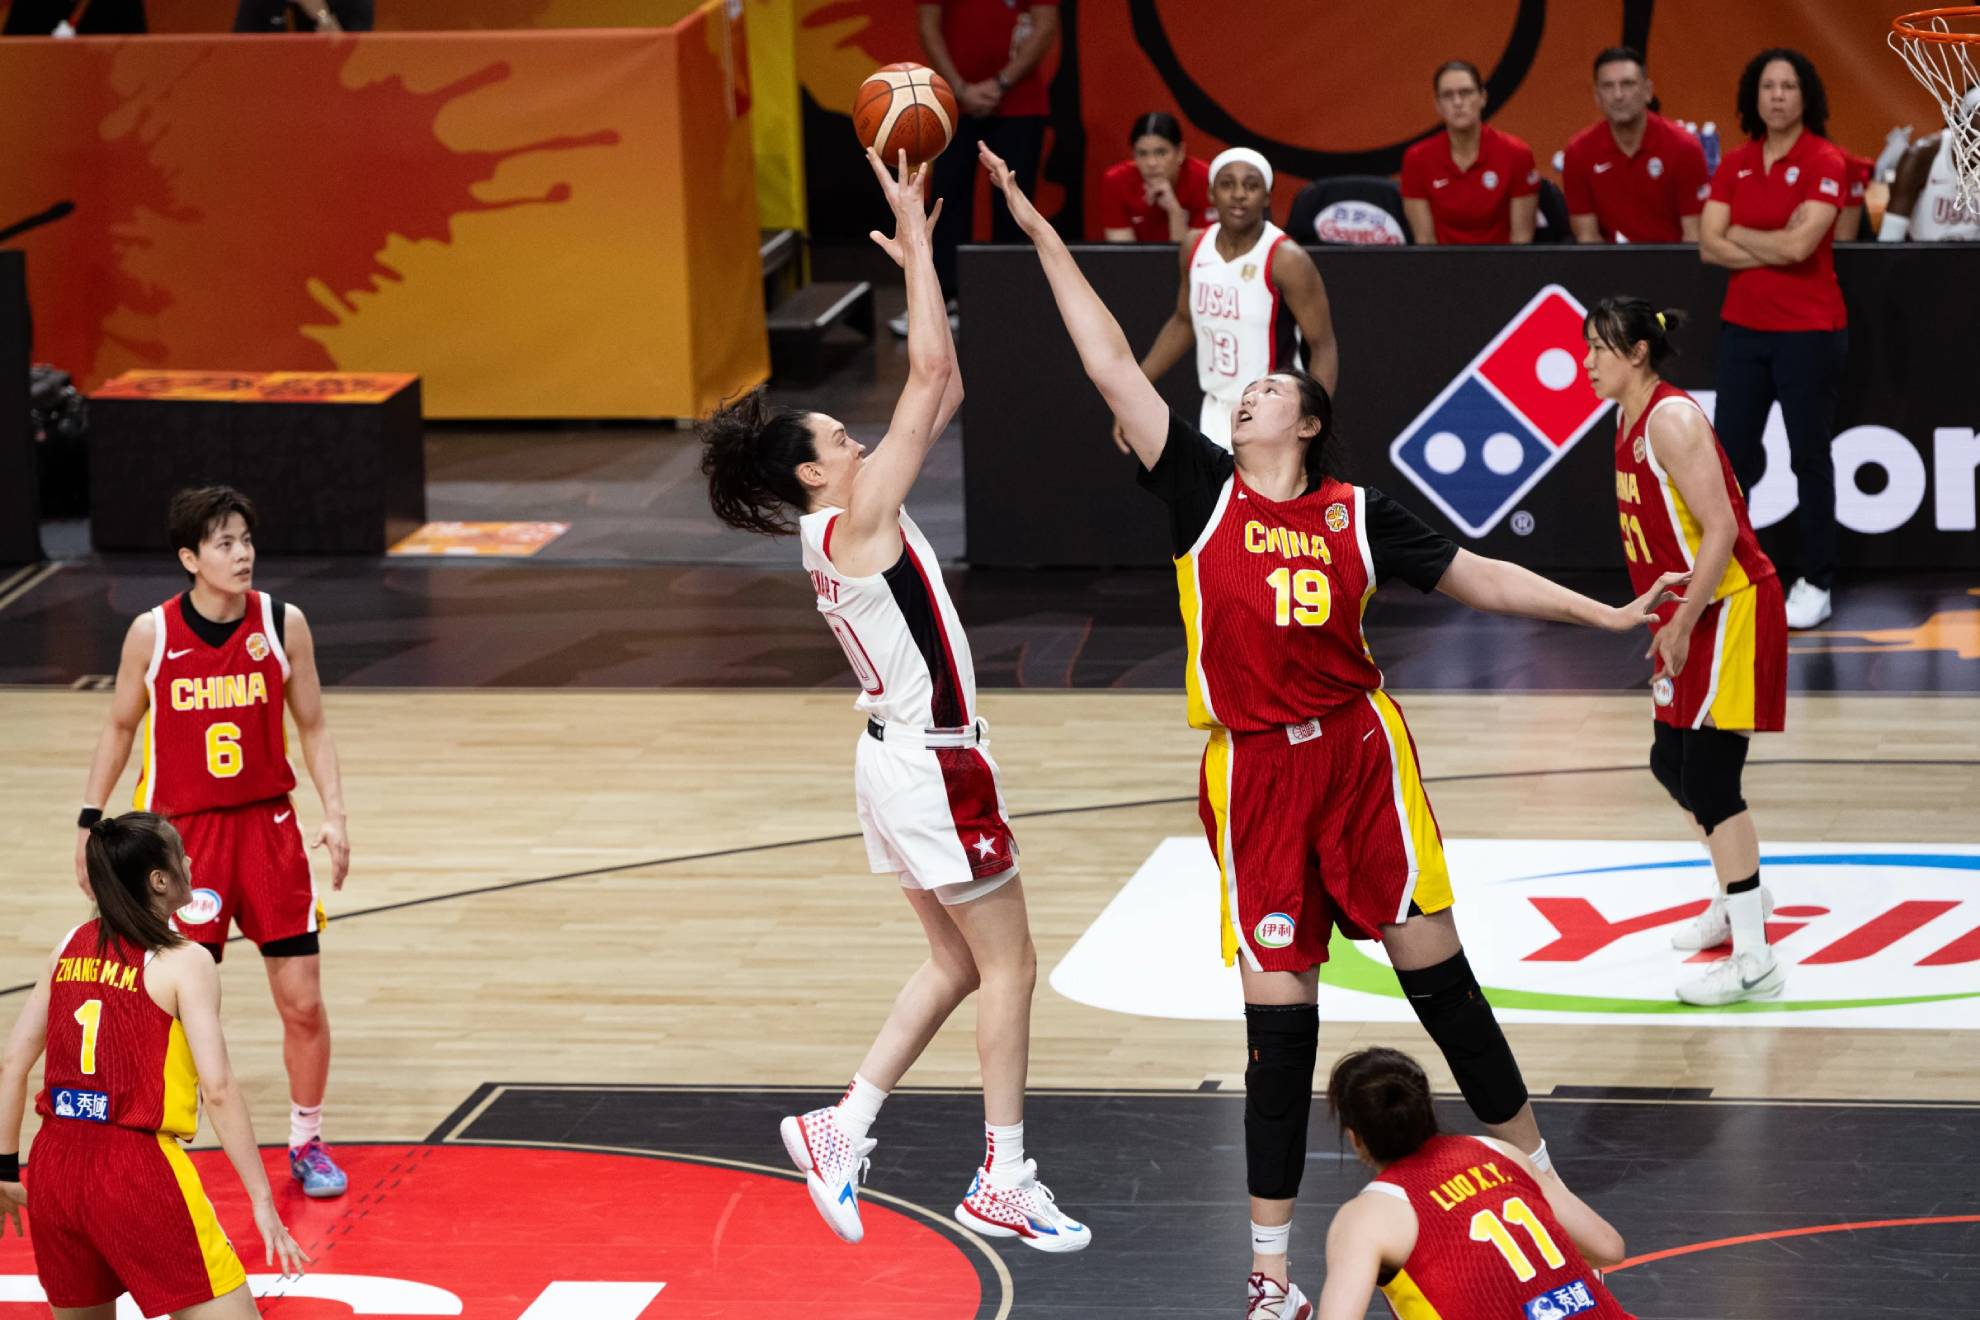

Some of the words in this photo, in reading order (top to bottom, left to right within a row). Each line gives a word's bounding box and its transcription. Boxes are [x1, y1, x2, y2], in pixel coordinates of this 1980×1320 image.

[1197, 281, 1240, 320] USA
[1201, 325, 1239, 377] 13
[1244, 519, 1332, 565] CHINA
[1265, 567, 1332, 626] 19
[171, 671, 269, 711] CHINA
[205, 721, 244, 779] 6
[1262, 922, 1291, 938] 伊利
[55, 957, 101, 983] ZHANG
[99, 959, 139, 993] M.M.
[73, 998, 103, 1076] 1
[76, 1092, 108, 1121] 秀域
[1429, 1173, 1478, 1212] LUO
[1467, 1161, 1514, 1192] X.Y.
[1468, 1196, 1567, 1283] 11
[1552, 1280, 1596, 1315] 秀域
